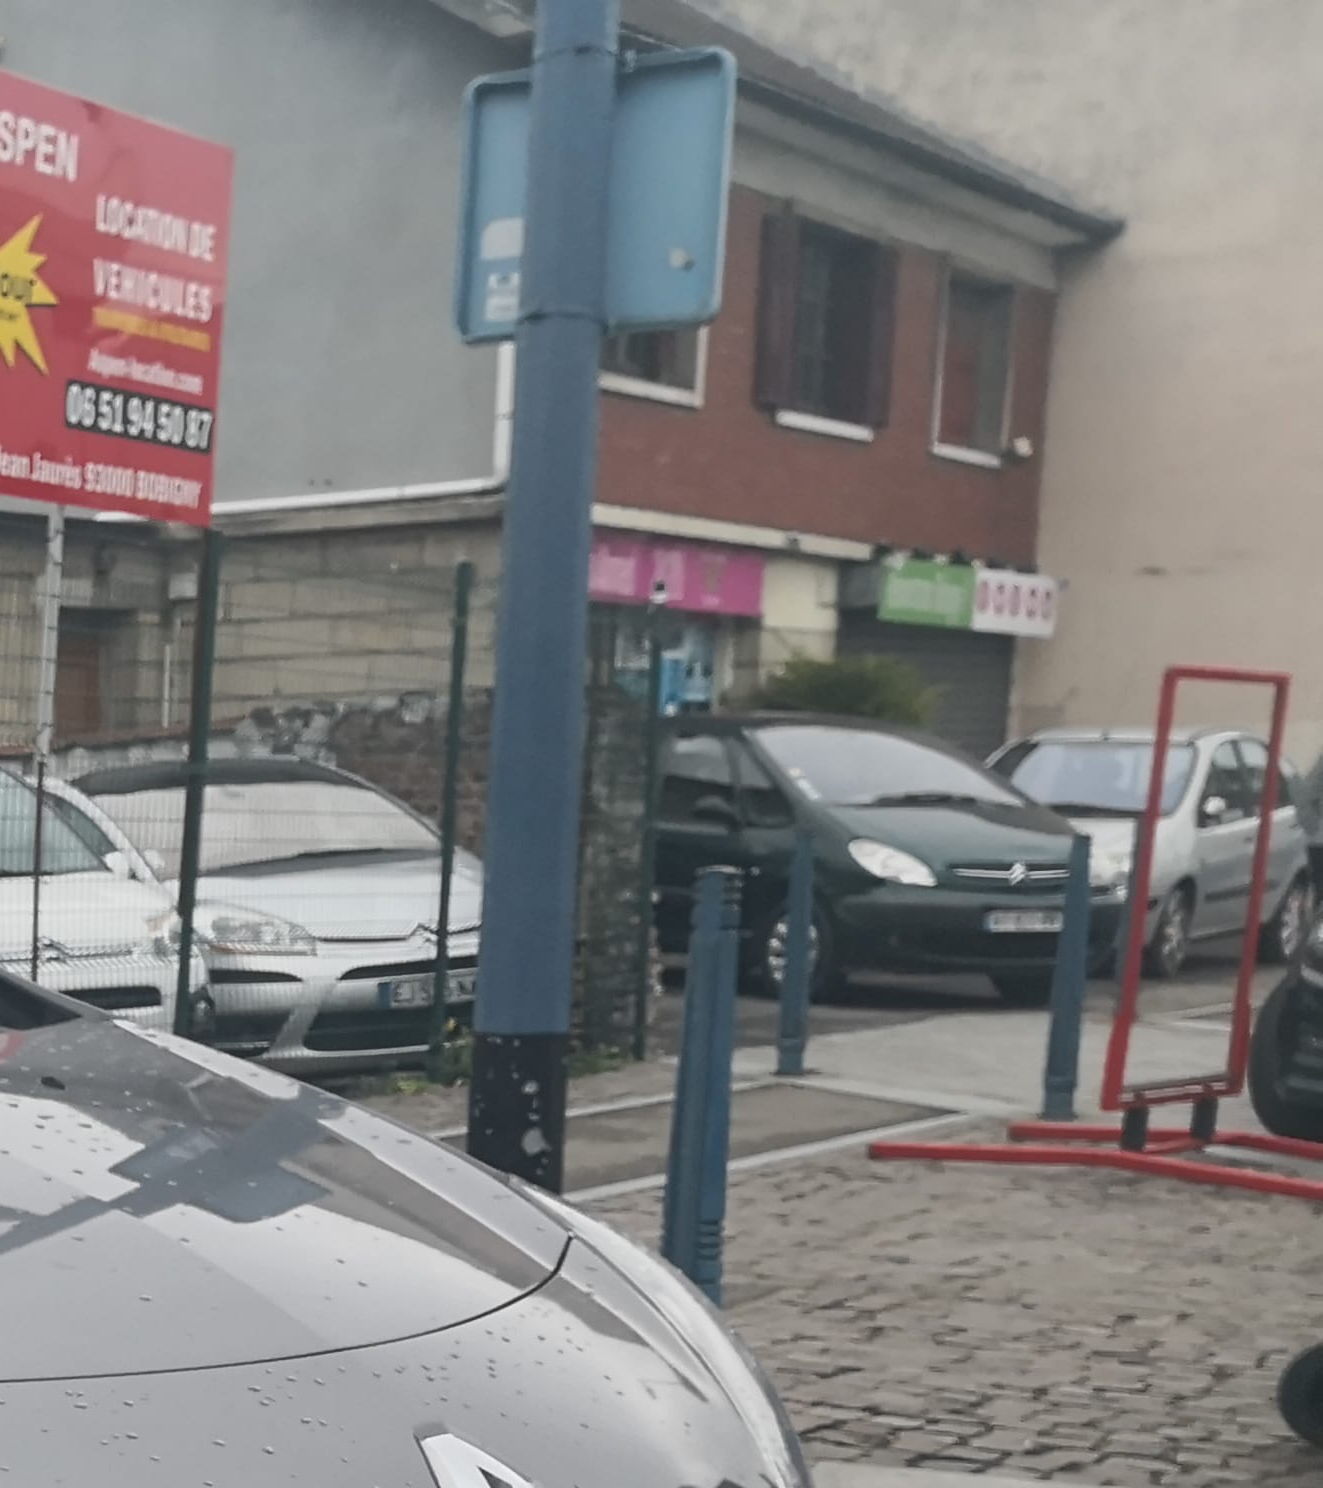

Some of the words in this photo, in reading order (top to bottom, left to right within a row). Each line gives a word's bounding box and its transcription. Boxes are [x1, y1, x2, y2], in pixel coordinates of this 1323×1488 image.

[95, 194, 188, 254] LOCATION
[188, 220, 217, 262] DE
[97, 390, 125, 434] 51
[127, 396, 155, 439] 94
